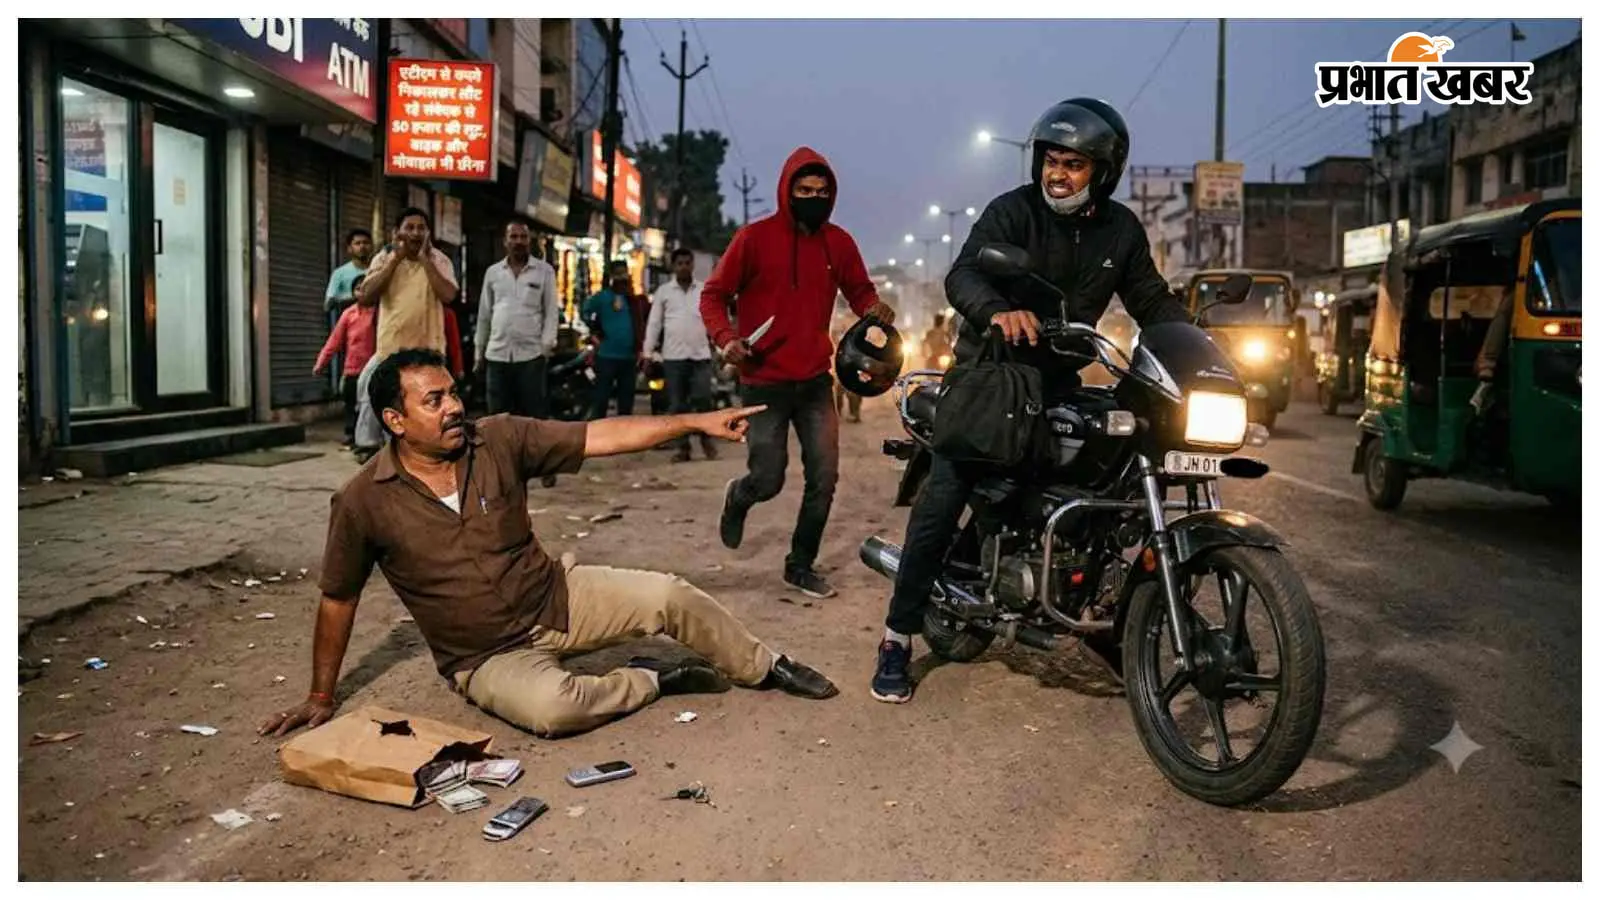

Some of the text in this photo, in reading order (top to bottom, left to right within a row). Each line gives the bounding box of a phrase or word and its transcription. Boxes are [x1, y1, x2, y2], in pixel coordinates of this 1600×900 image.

[327, 42, 370, 99] ATM
[440, 66, 452, 80] से
[392, 120, 409, 133] 50
[1202, 458, 1218, 474] 01
